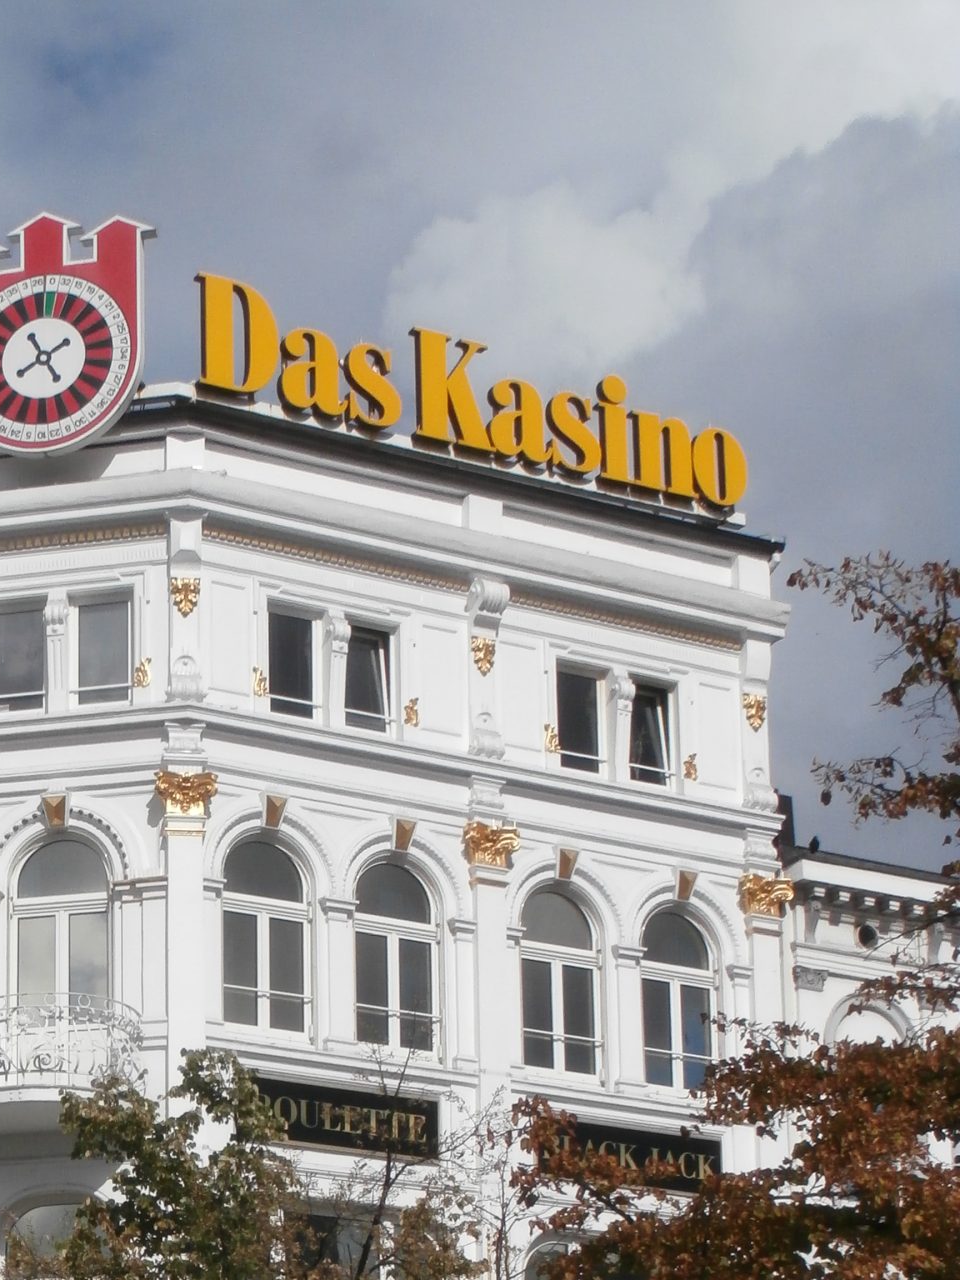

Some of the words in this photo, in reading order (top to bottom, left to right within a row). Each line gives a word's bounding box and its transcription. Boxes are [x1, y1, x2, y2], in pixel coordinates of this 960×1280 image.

[193, 271, 403, 431] Das
[408, 326, 748, 507] Kasino
[645, 1147, 716, 1180] JACK
